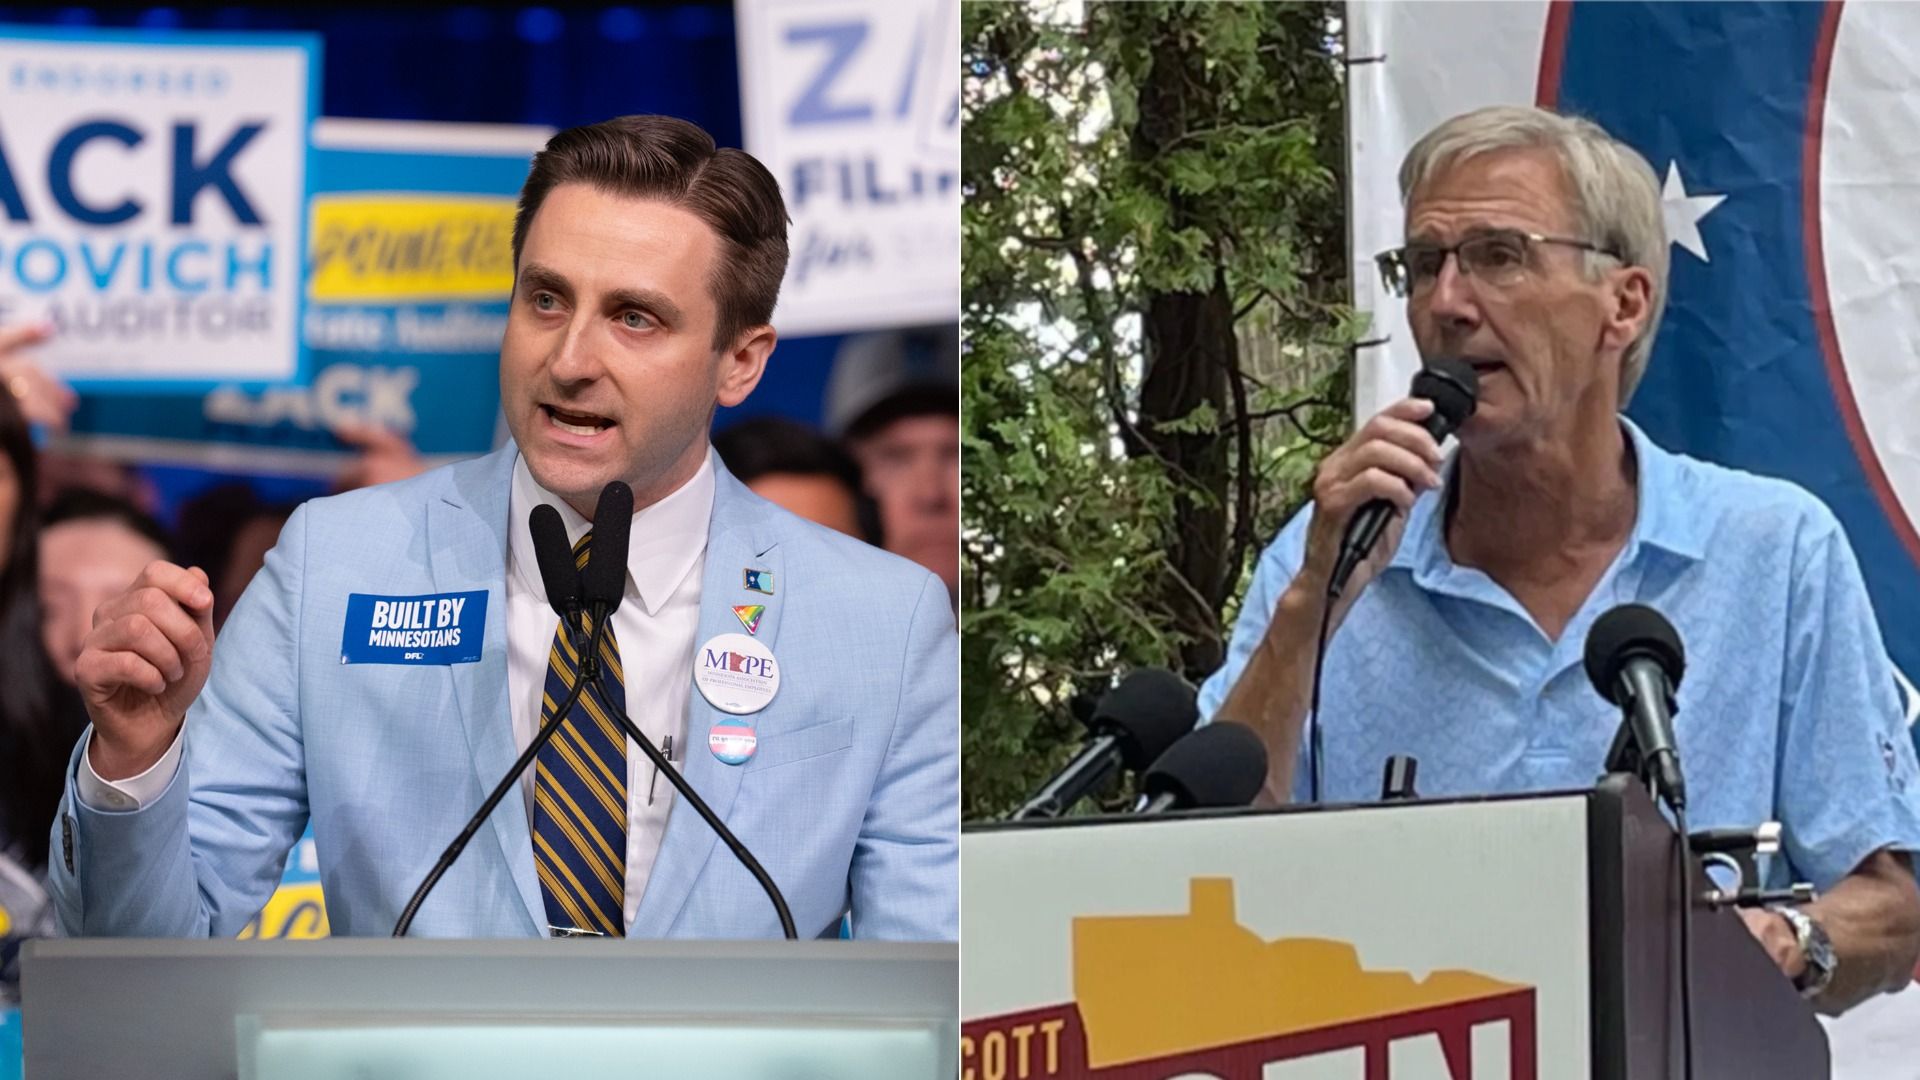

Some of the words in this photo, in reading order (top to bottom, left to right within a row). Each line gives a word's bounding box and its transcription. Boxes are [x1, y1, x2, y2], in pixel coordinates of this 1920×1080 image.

[0, 238, 274, 293] OVICH
[371, 600, 436, 630] BUILT
[437, 597, 466, 628] BY
[368, 628, 462, 648] MINNESOTANS
[404, 652, 421, 660] DFL
